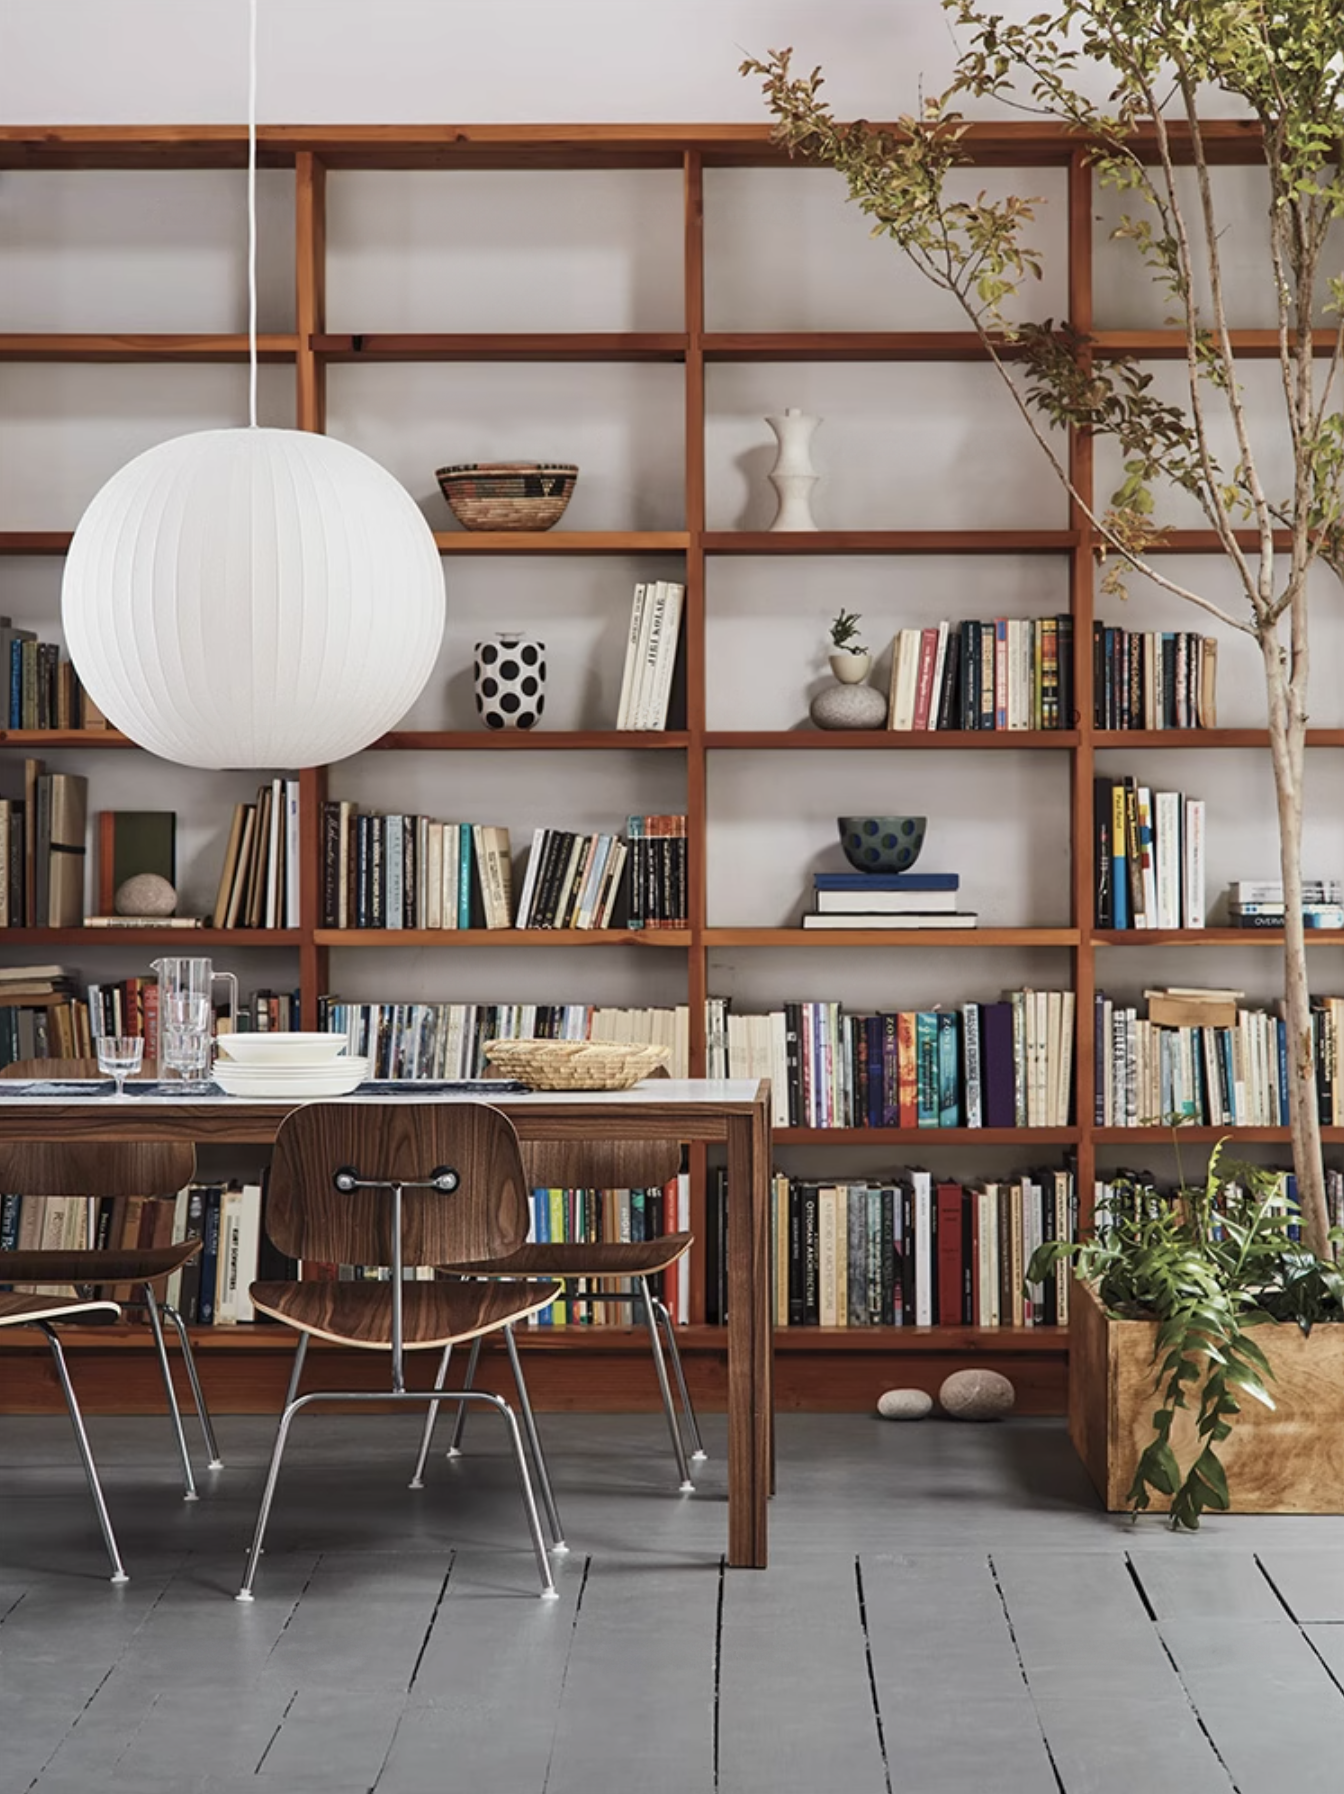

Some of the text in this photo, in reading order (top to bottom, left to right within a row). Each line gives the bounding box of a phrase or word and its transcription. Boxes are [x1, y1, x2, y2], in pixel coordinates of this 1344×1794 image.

[886, 1016, 895, 1051] ZONE
[943, 1016, 952, 1051] ZONE
[229, 1228, 239, 1290] KURT SCHWITTERS
[806, 1201, 815, 1306] OTTOMAN ARCHITECTURE
